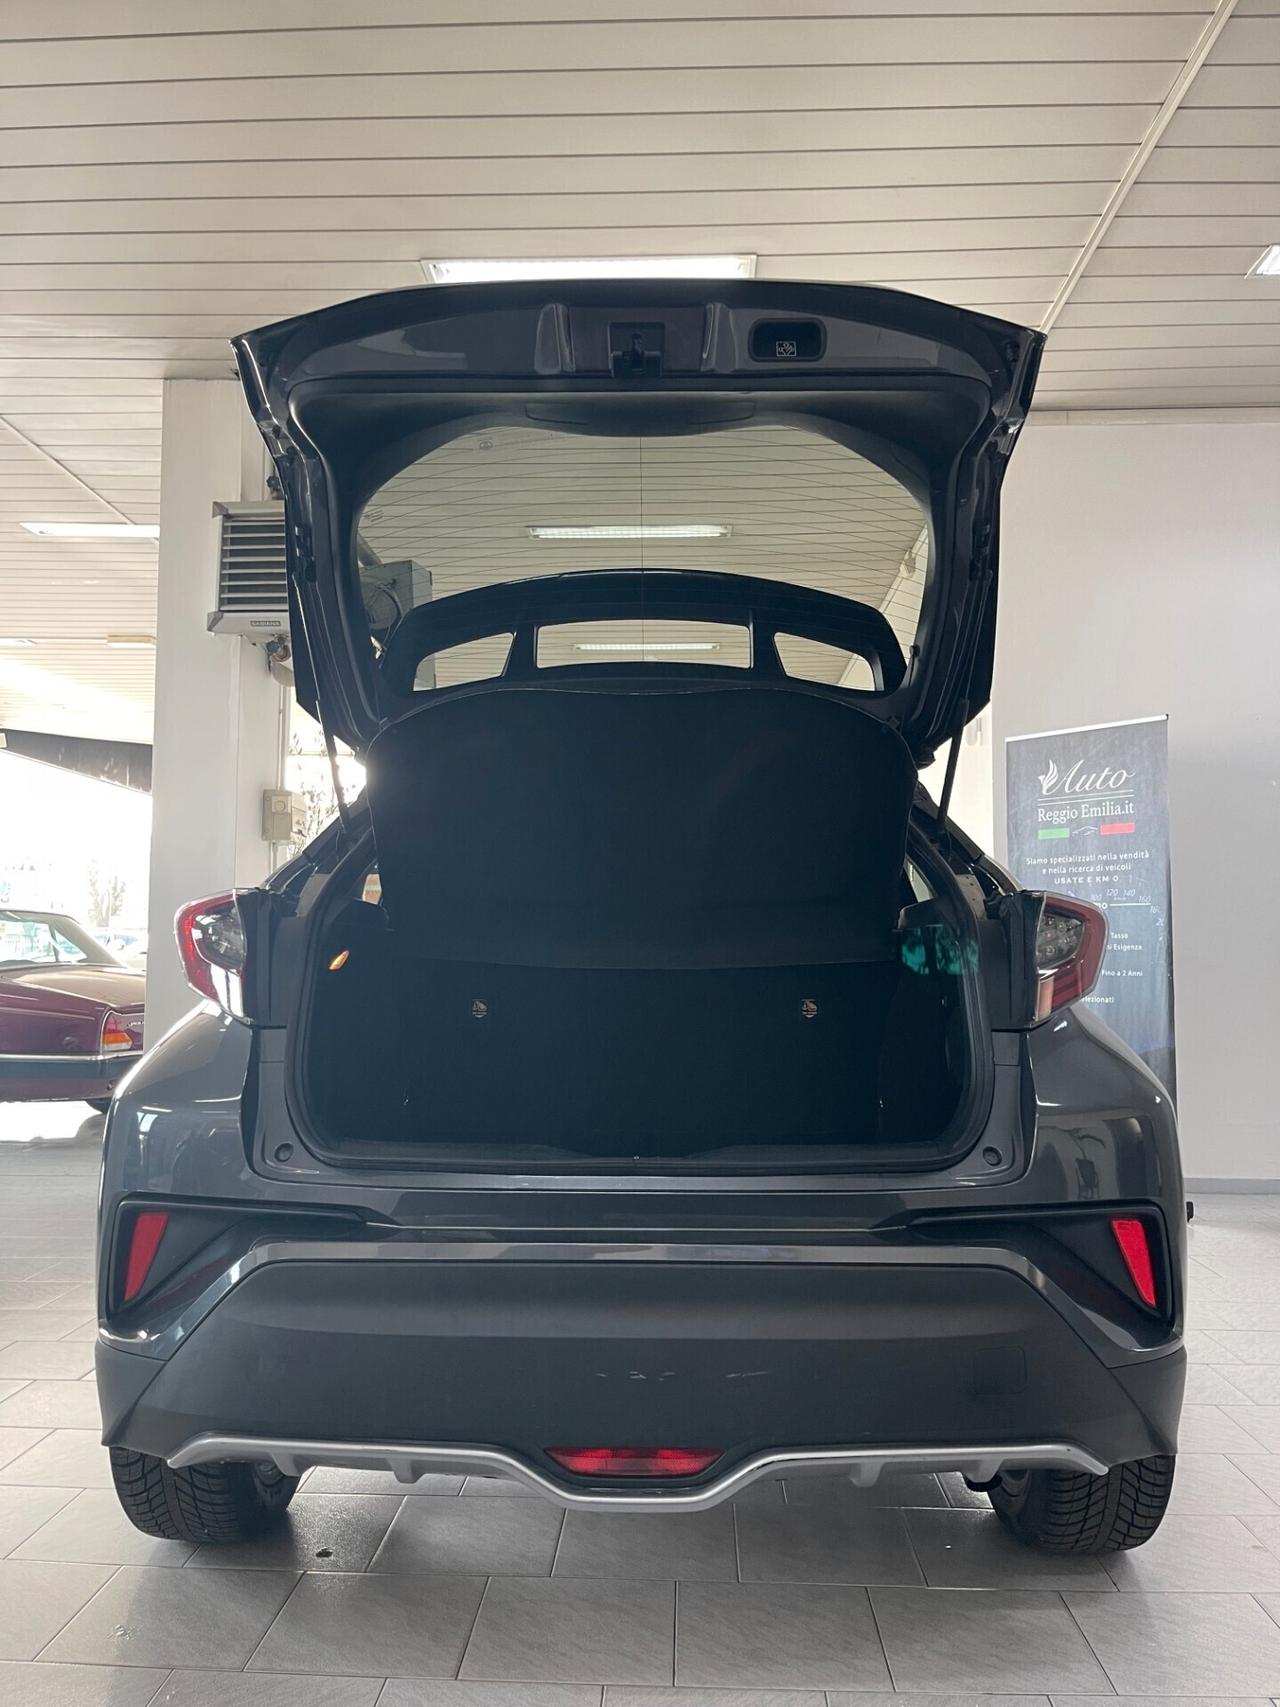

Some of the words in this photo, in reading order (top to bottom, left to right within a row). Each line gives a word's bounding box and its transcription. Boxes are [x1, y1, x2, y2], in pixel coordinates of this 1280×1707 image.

[1038, 758, 1136, 795] Auto
[1037, 806, 1078, 824] Reggio
[1081, 800, 1135, 818] Emilia.it
[1026, 857, 1048, 865] Siamo
[1050, 853, 1096, 865] specializzati
[1098, 852, 1118, 861] nella
[1048, 866, 1067, 874] nella
[1068, 864, 1094, 873] ricerca
[1096, 863, 1103, 871] di
[1105, 862, 1131, 871] veicoli
[1054, 877, 1084, 885] USATE
[1113, 943, 1142, 951] Esigenza
[1101, 969, 1115, 977] Fino
[1122, 969, 1127, 977] 2
[1128, 969, 1143, 977] Anni
